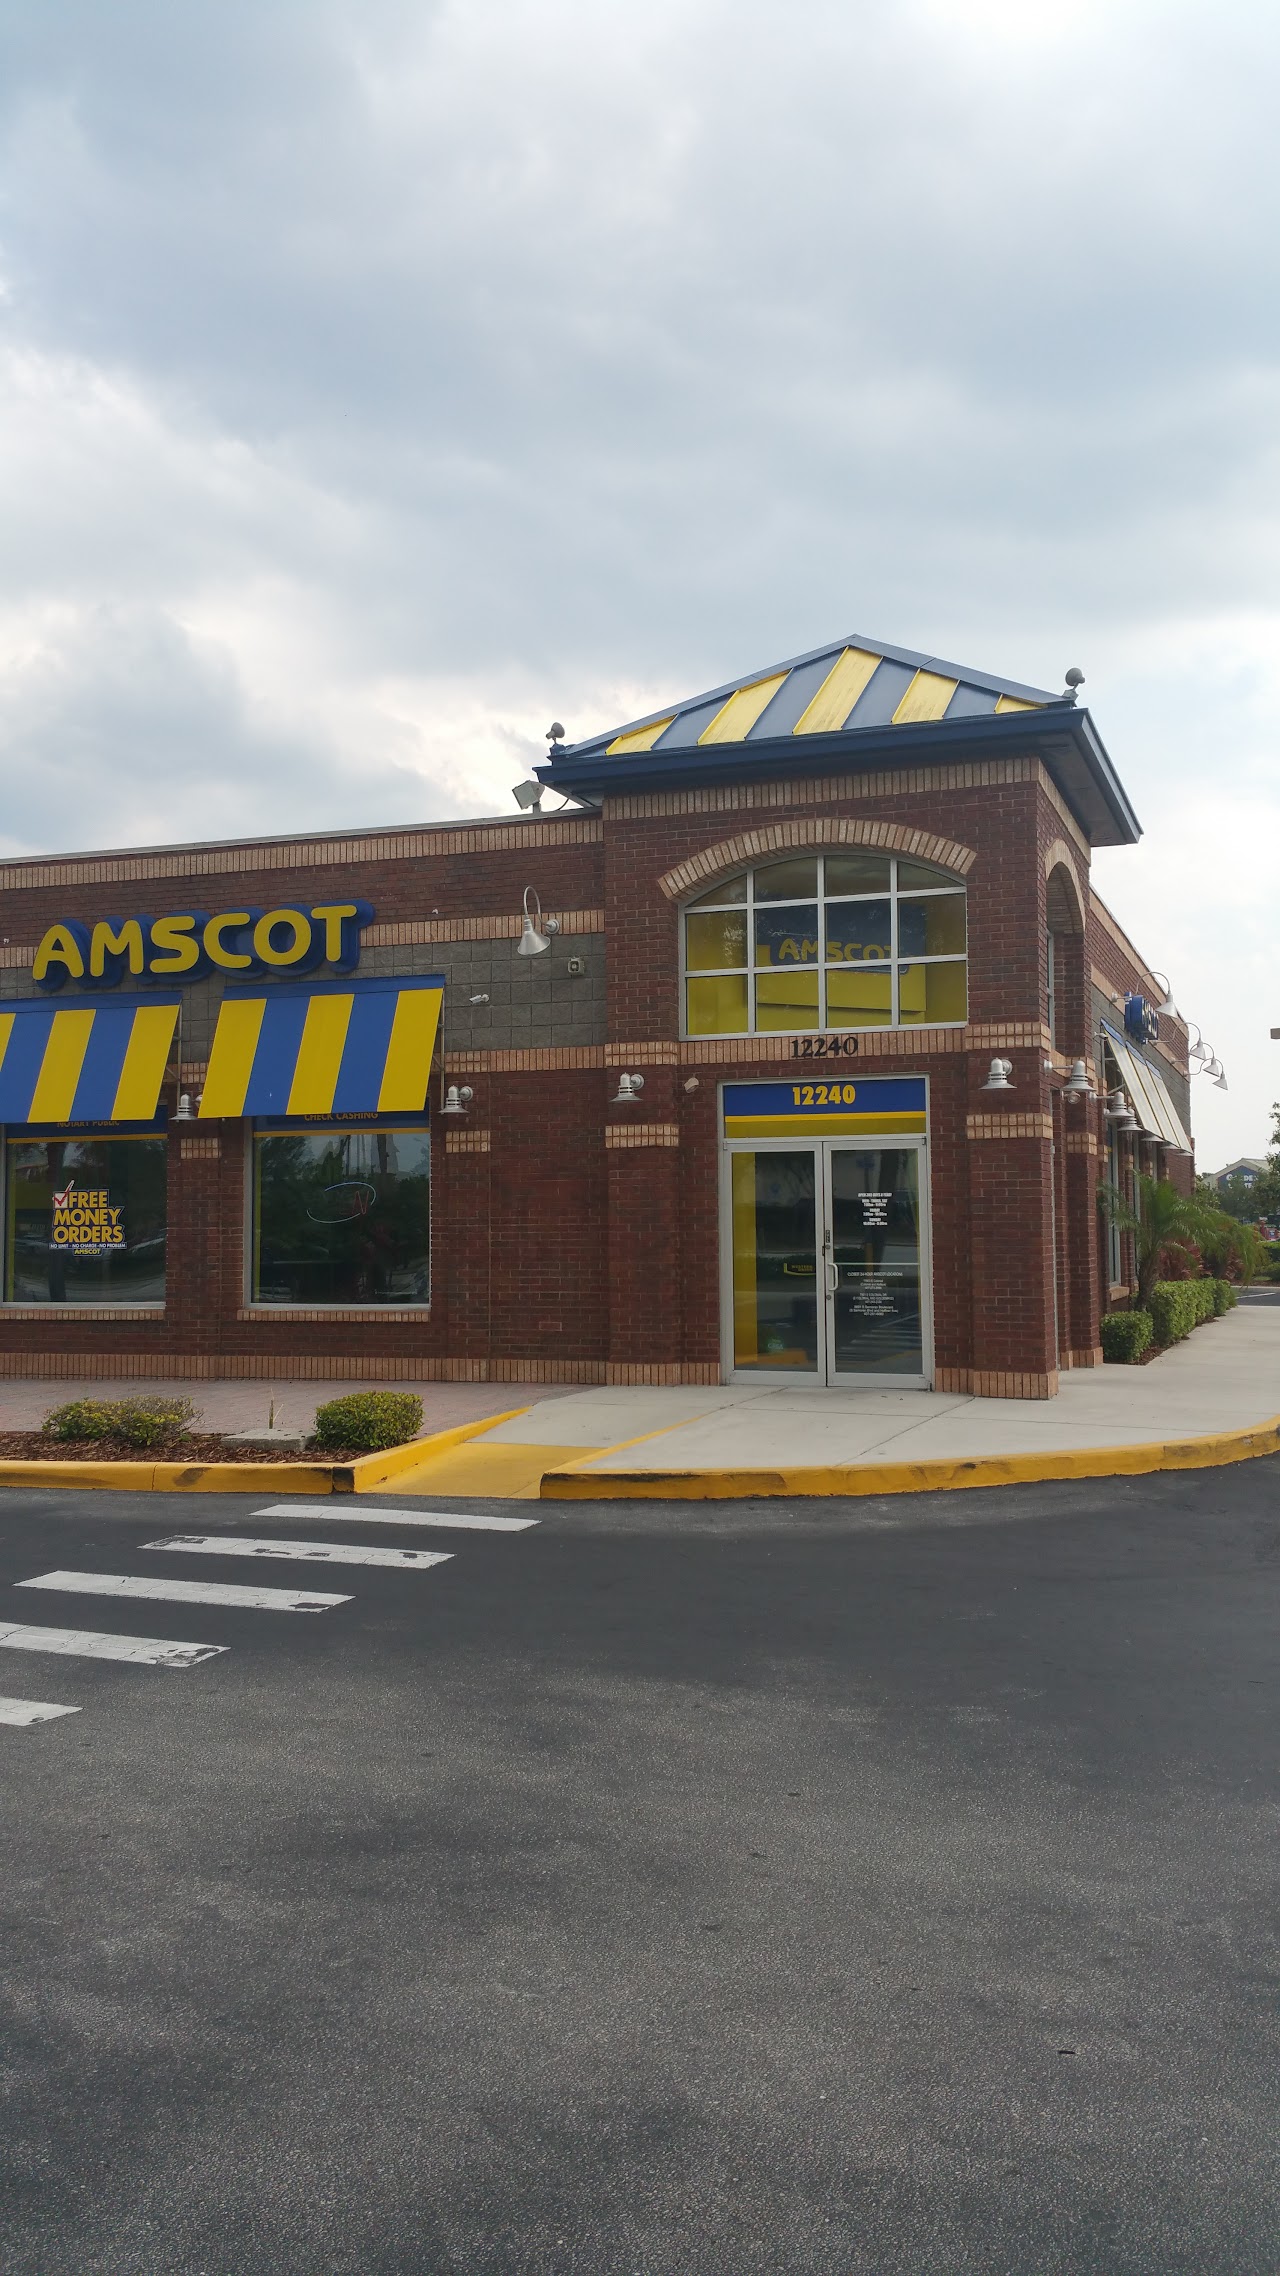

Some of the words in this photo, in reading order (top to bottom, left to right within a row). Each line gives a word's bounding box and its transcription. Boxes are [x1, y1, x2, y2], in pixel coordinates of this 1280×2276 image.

[32, 903, 358, 981] AMSCOT
[791, 1035, 859, 1058] 12240
[792, 1084, 856, 1106] 12240
[68, 1191, 108, 1208] FREE
[53, 1208, 121, 1226] MONEY
[53, 1226, 123, 1243] ORDERS
